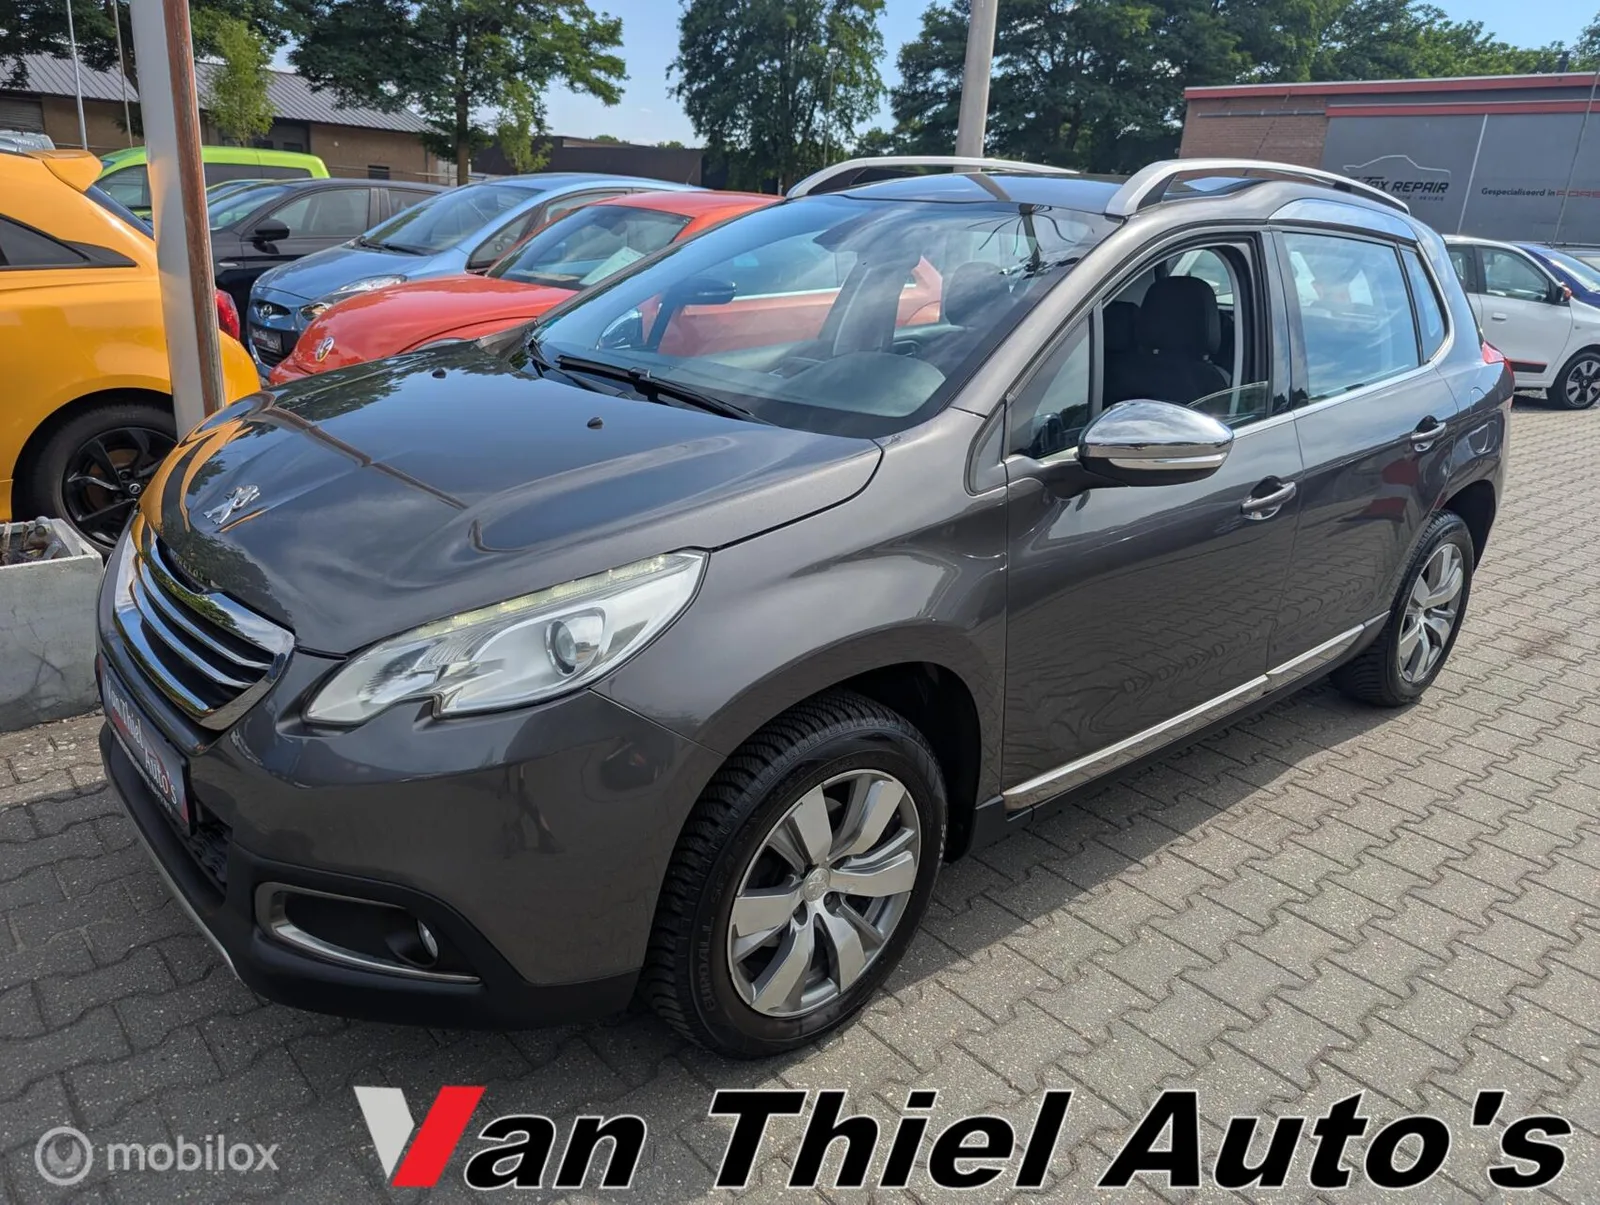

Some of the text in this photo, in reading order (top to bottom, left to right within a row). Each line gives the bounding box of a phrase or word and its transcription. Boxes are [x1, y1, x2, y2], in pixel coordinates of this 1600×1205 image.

[1391, 181, 1449, 194] REPAIR
[1481, 187, 1546, 197] Gespecialiseerd
[1547, 189, 1556, 197] in
